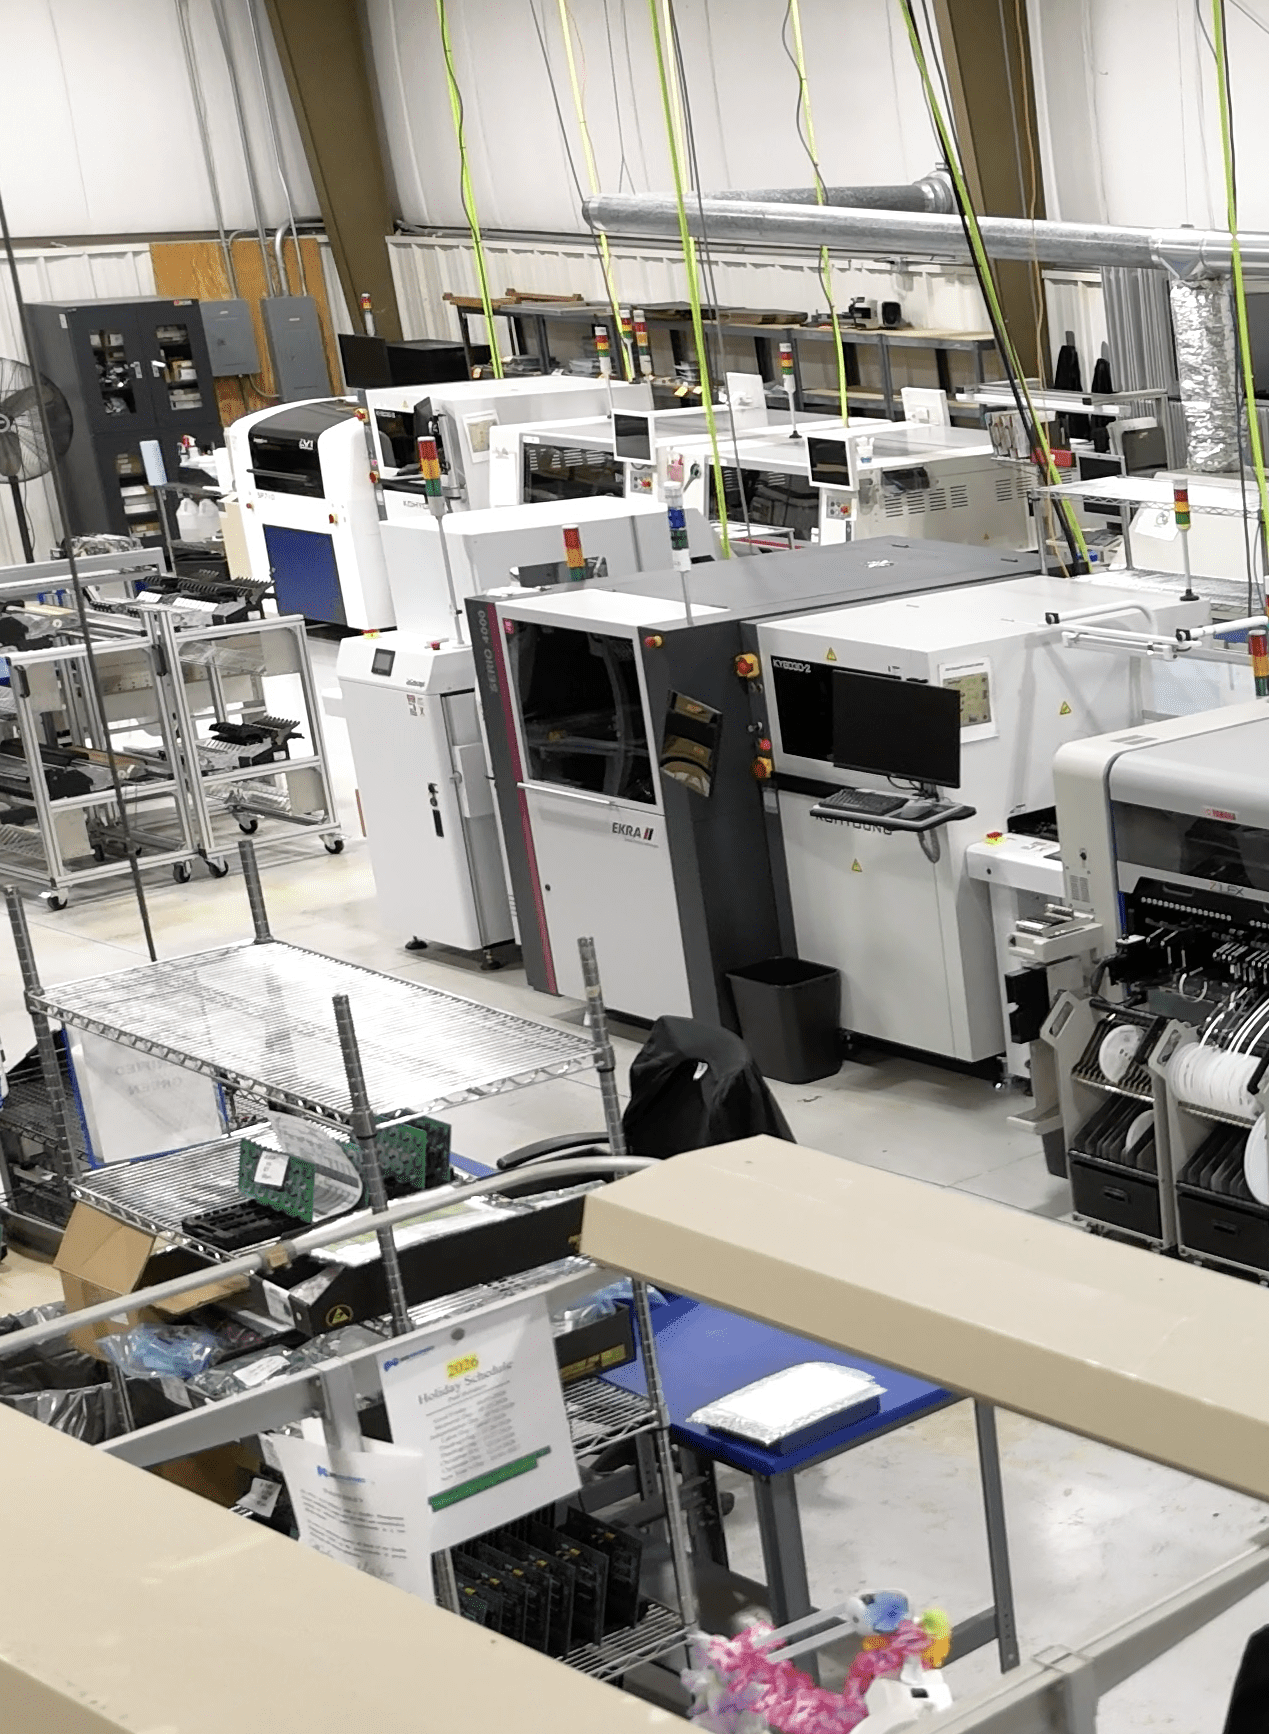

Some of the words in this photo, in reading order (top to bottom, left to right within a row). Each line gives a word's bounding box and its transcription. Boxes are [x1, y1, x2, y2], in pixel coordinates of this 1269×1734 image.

[477, 609, 490, 644] 4000
[483, 648, 499, 693] SERIO
[612, 822, 642, 839] EKRA
[418, 1383, 460, 1405] Holiday
